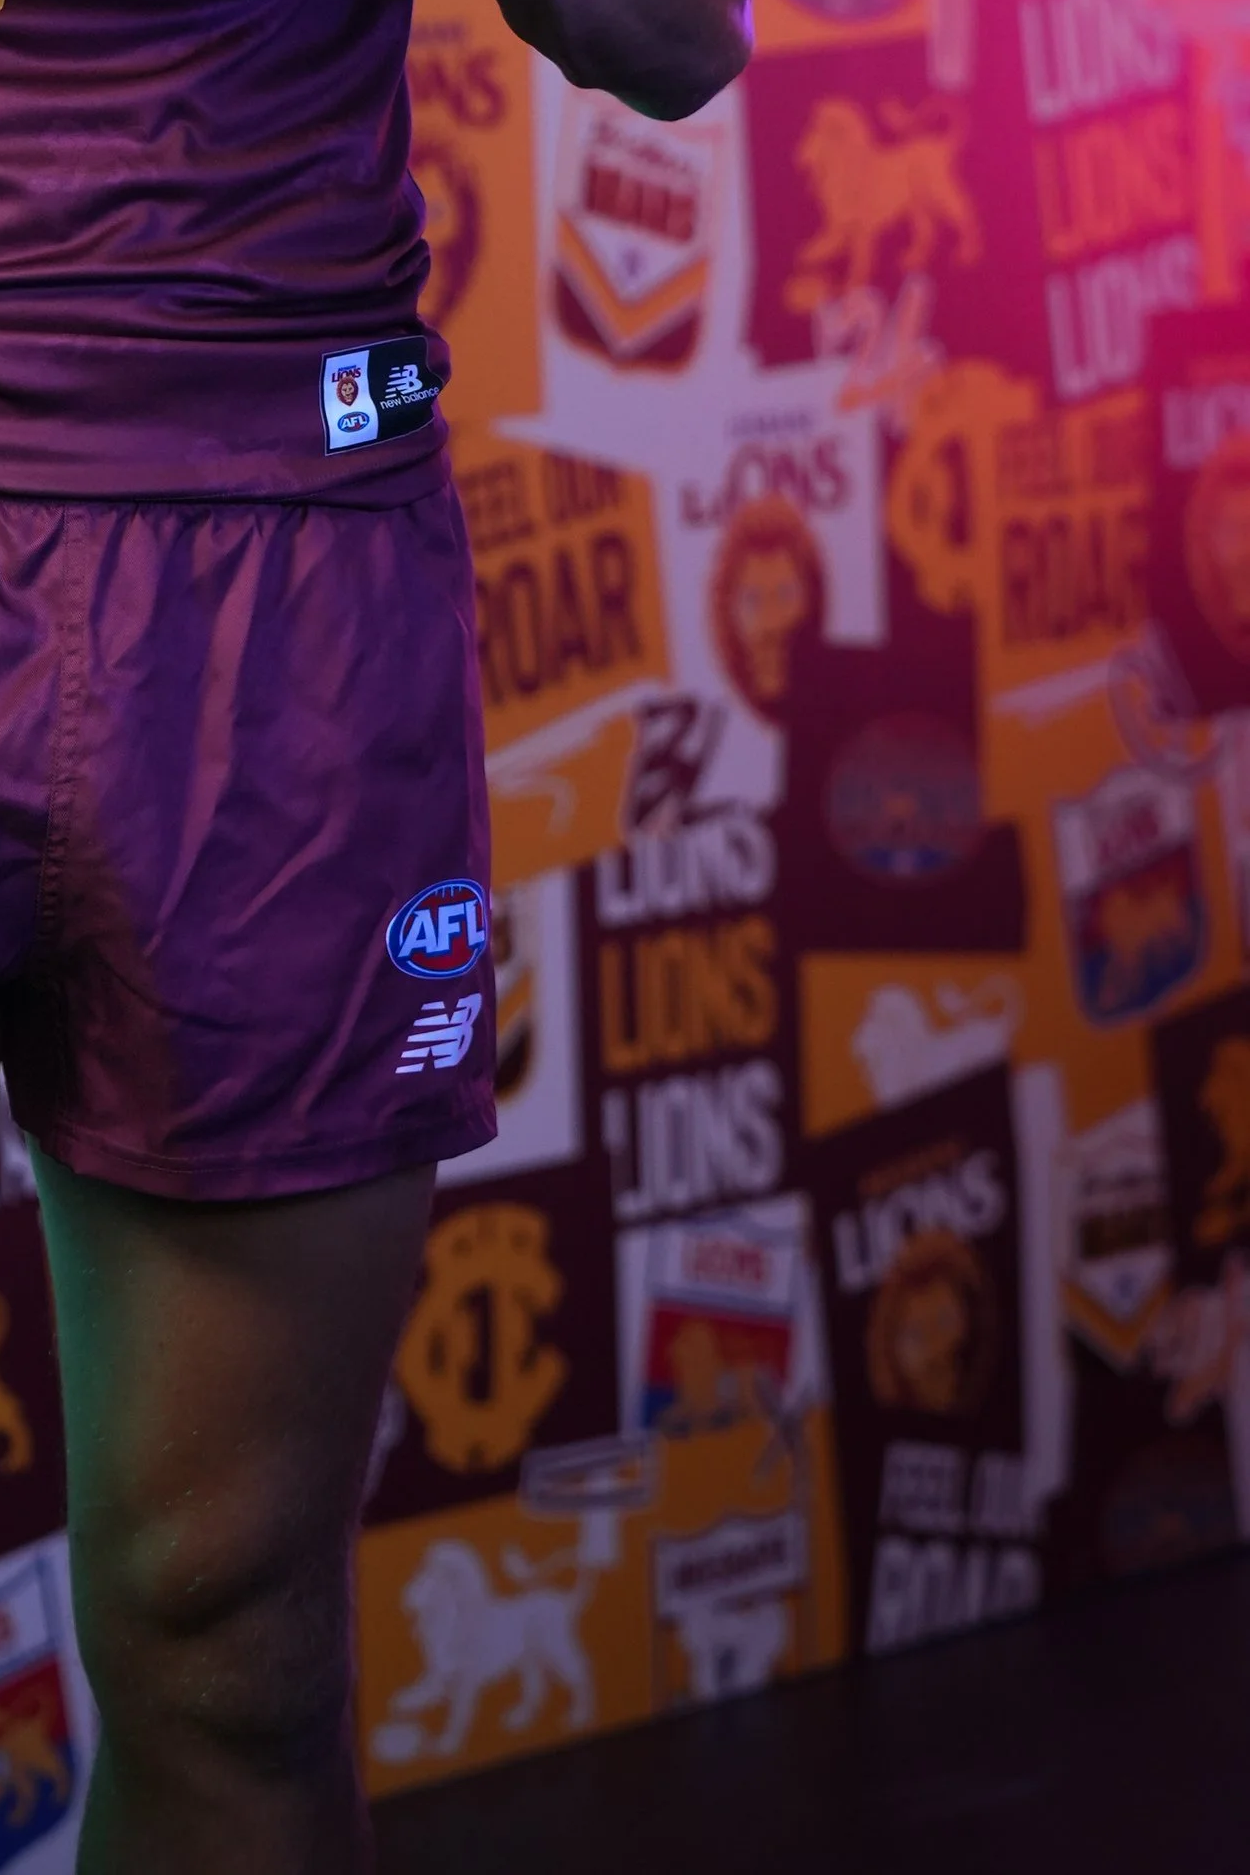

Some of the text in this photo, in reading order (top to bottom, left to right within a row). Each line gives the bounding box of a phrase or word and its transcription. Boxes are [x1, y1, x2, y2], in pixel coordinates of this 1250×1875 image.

[379, 385, 440, 410] new balance
[341, 414, 368, 429] AFL
[398, 900, 485, 958] AFL
